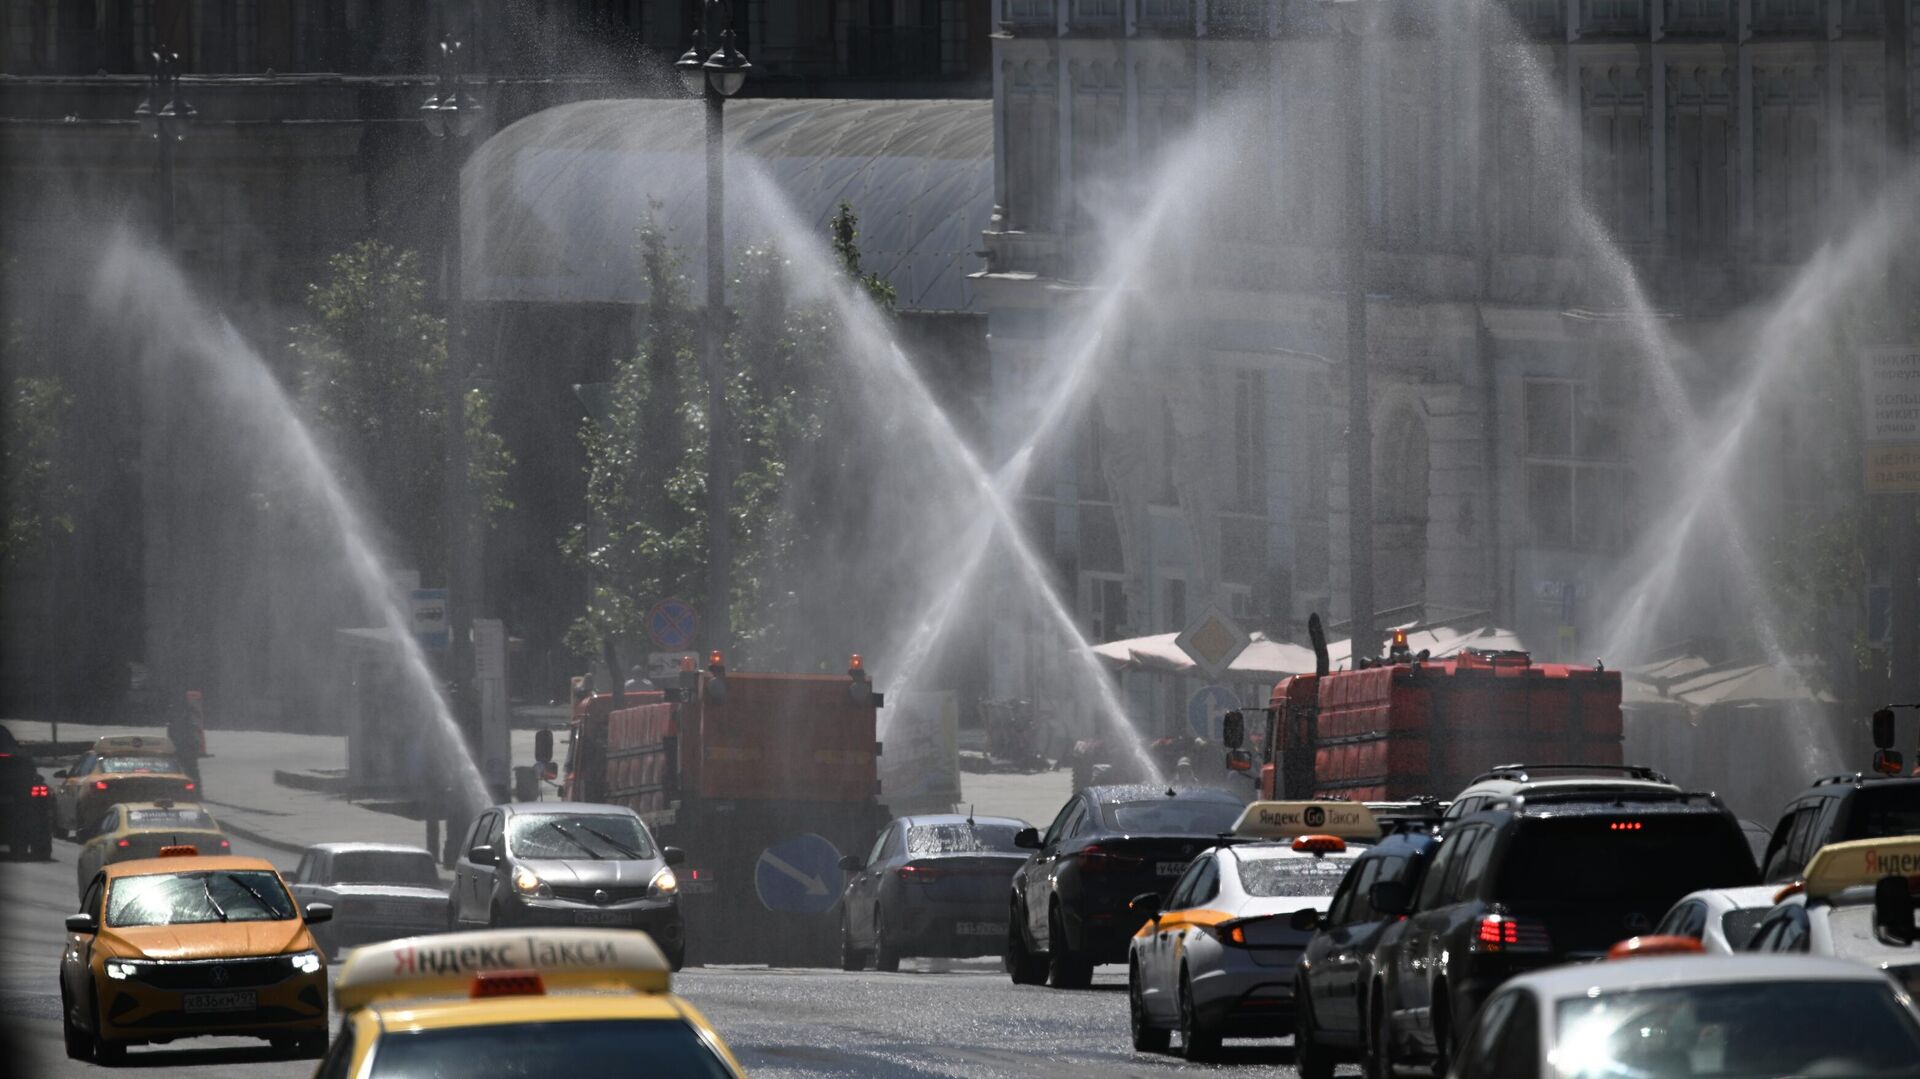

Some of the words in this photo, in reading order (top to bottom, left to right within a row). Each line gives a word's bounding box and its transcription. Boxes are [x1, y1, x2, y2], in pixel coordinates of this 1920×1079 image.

[1259, 809, 1301, 827] Яндекс
[1306, 808, 1324, 825] Go
[1328, 809, 1360, 825] Такси
[394, 942, 516, 976] Яндекс
[525, 936, 618, 966] Такси
